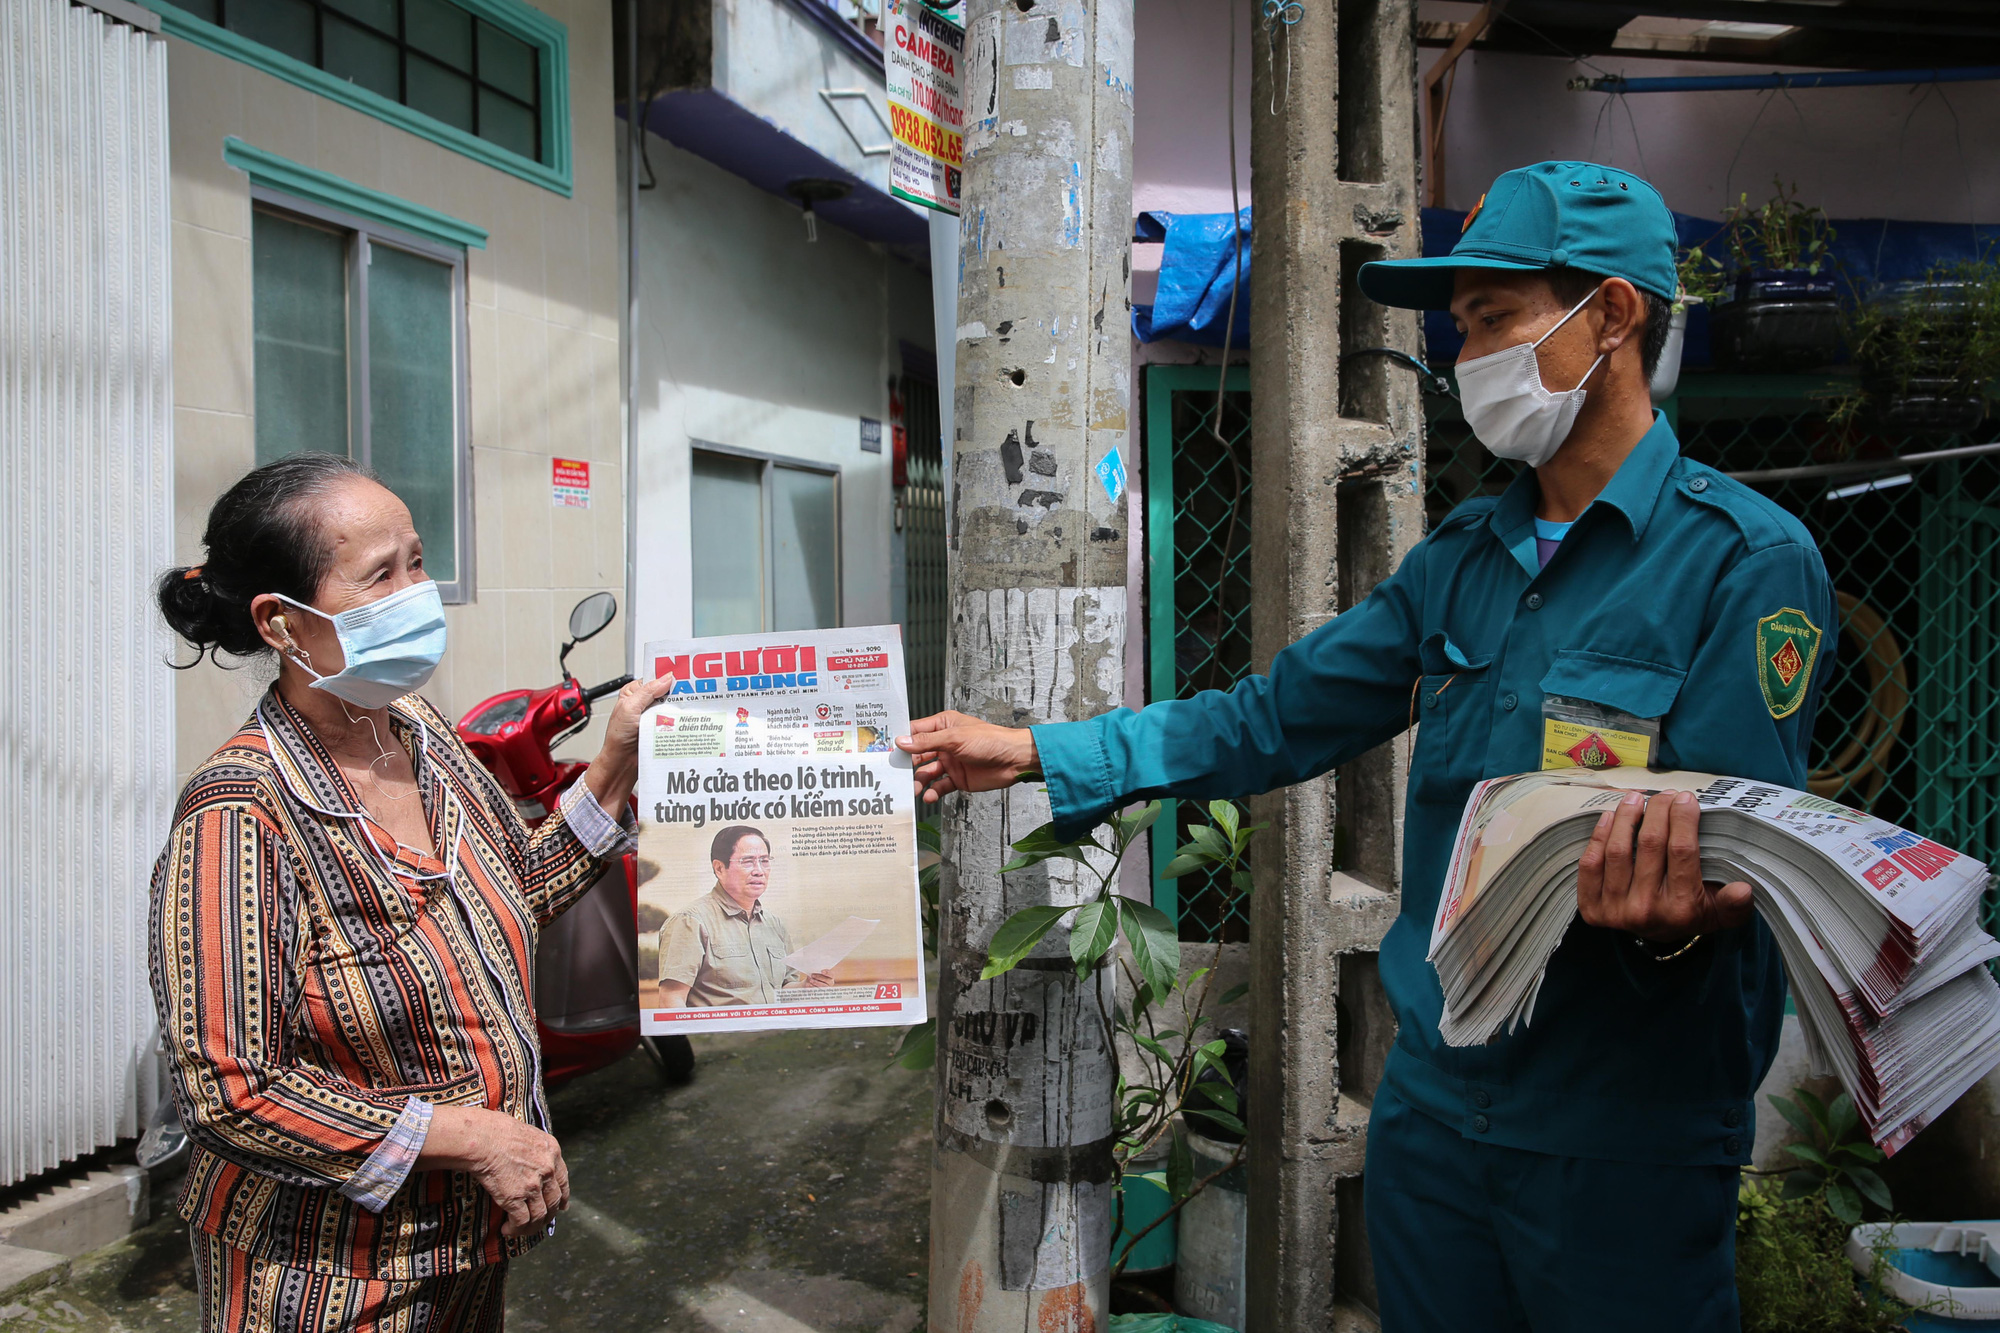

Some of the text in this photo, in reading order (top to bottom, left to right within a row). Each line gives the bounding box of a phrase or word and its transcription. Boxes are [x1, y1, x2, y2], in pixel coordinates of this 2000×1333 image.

[918, 9, 965, 54] INTERNET
[894, 24, 955, 78] CAMERA
[911, 61, 926, 79] CHO
[865, 645, 882, 653] 9090
[655, 644, 817, 681] NGƯỜI
[834, 654, 880, 665] CHỦ NHẬT
[670, 671, 818, 696] AO ĐỘNG
[667, 695, 684, 703] QUAN
[686, 694, 699, 702] CỦA
[702, 692, 724, 701] THÀNH
[737, 690, 759, 698] THÀNH
[761, 687, 775, 696] PHỐ
[777, 686, 787, 695] HỒ
[789, 685, 800, 695] CHÍ
[766, 708, 784, 716] Ngành
[868, 701, 884, 710] Trung
[678, 723, 700, 732] chiến
[679, 715, 700, 723] Niềm
[666, 768, 700, 795] Mở
[702, 767, 739, 794] cửa
[743, 767, 793, 792] theo
[821, 764, 882, 792] trình,
[654, 791, 894, 828] từng bước có kiểm soát
[879, 984, 899, 998] 2-3
[675, 1012, 691, 1020] LUÔN
[693, 1010, 710, 1019] ĐỒNG
[730, 1009, 741, 1017] VỚI
[743, 1009, 752, 1017] TỔ
[753, 1008, 769, 1016] CHỨC
[770, 1007, 787, 1016] CÔNG
[809, 1005, 826, 1014] CÔNG
[827, 1004, 844, 1013] NHÂN
[848, 1004, 861, 1013] LAO
[862, 1004, 880, 1013] ĐỘNG
